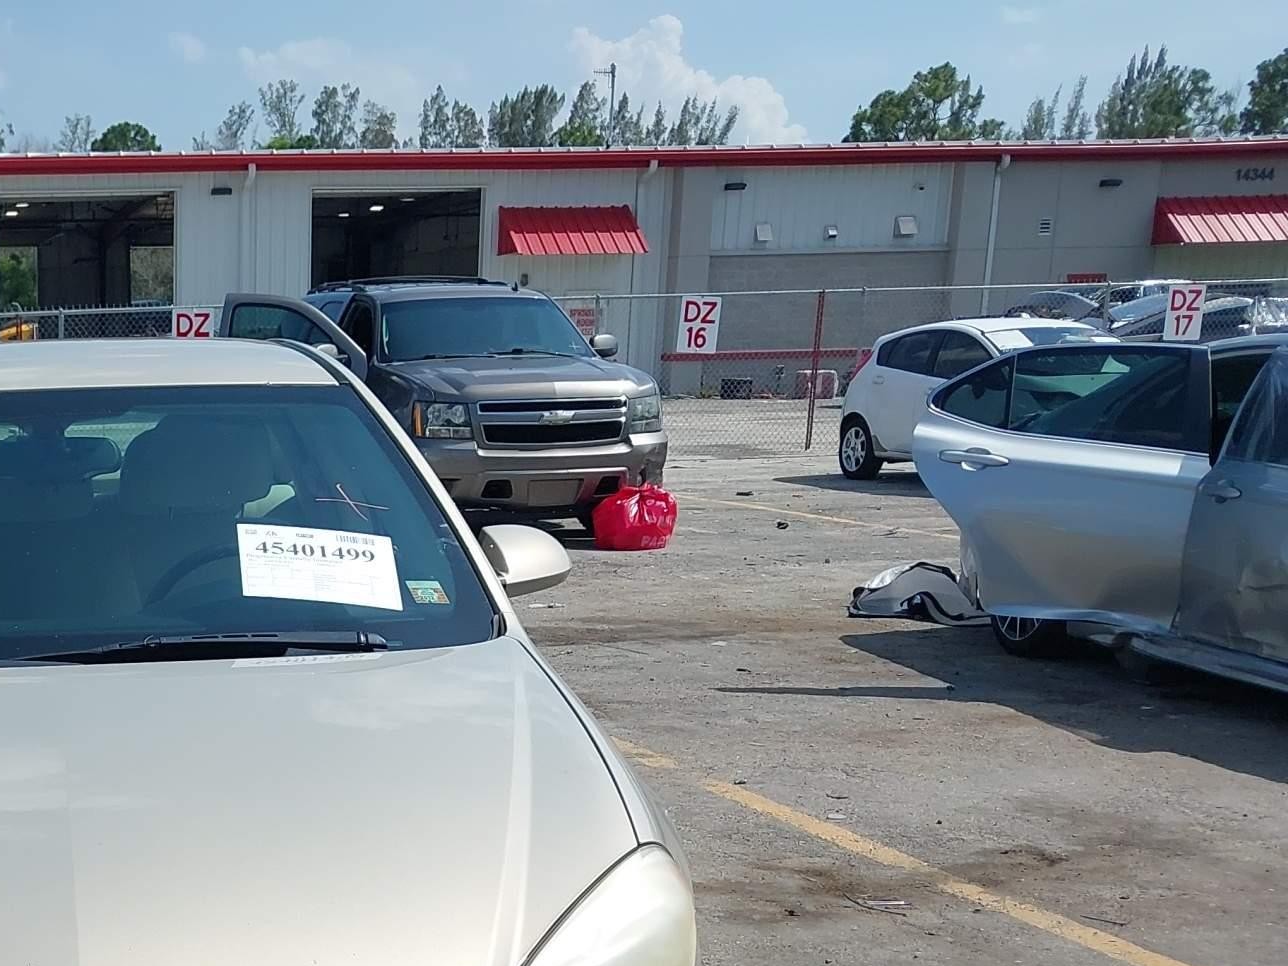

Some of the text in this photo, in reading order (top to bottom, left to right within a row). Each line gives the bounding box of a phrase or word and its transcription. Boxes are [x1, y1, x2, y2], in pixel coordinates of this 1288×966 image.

[1236, 168, 1274, 181] 14344
[1171, 289, 1202, 311] DZ
[684, 300, 717, 324] DZ
[176, 313, 210, 337] DZ
[1175, 315, 1193, 336] 17
[687, 327, 706, 348] 16
[255, 541, 375, 563] 45401499
